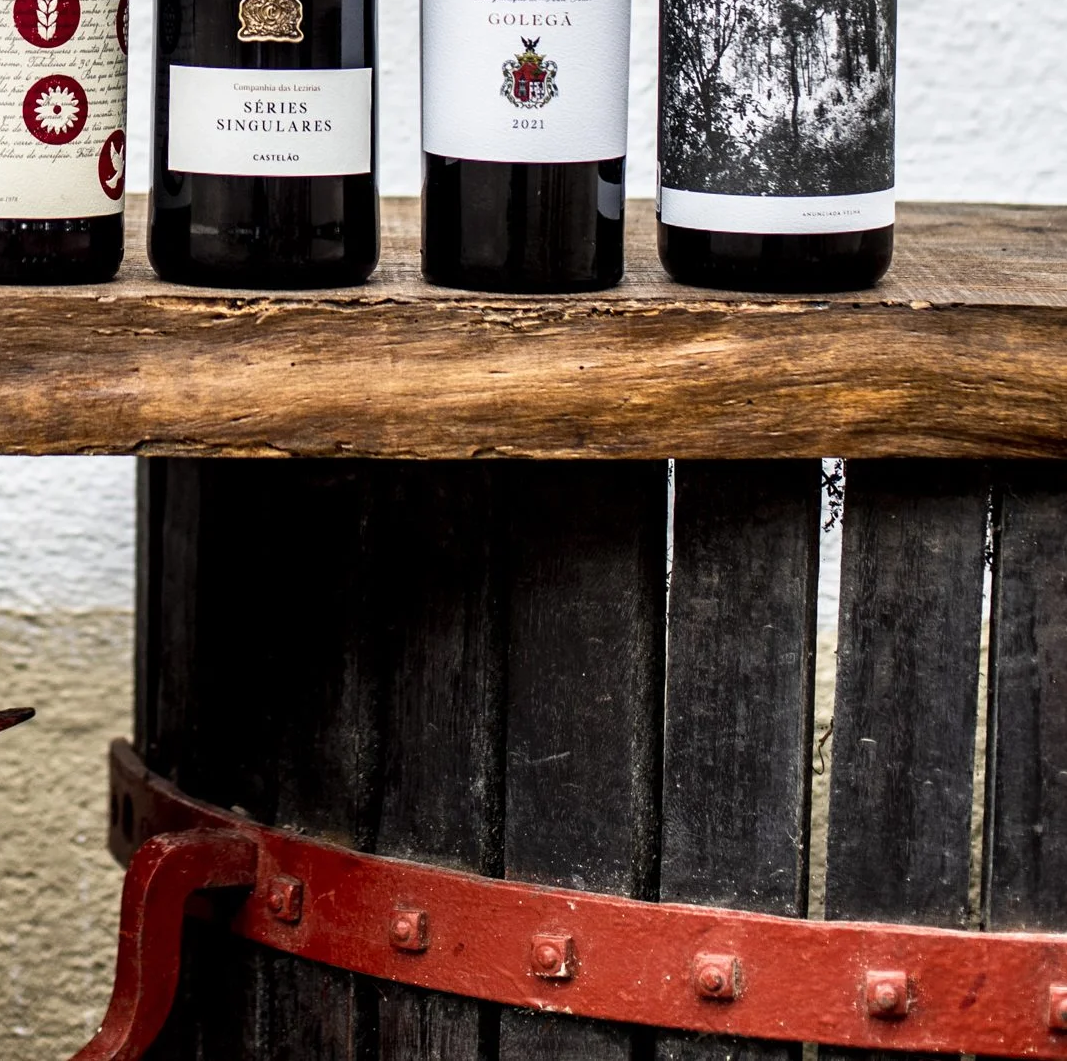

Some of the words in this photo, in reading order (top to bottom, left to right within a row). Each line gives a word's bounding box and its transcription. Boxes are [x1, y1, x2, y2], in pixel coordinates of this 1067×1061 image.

[488, 11, 572, 27] GOLEGÃ
[233, 83, 276, 93] Companhia
[278, 84, 292, 92] das
[243, 99, 308, 114] SÉRIES
[216, 118, 332, 133] SINGULARES
[512, 119, 545, 129] 2021
[252, 153, 300, 162] CASTELÃO
